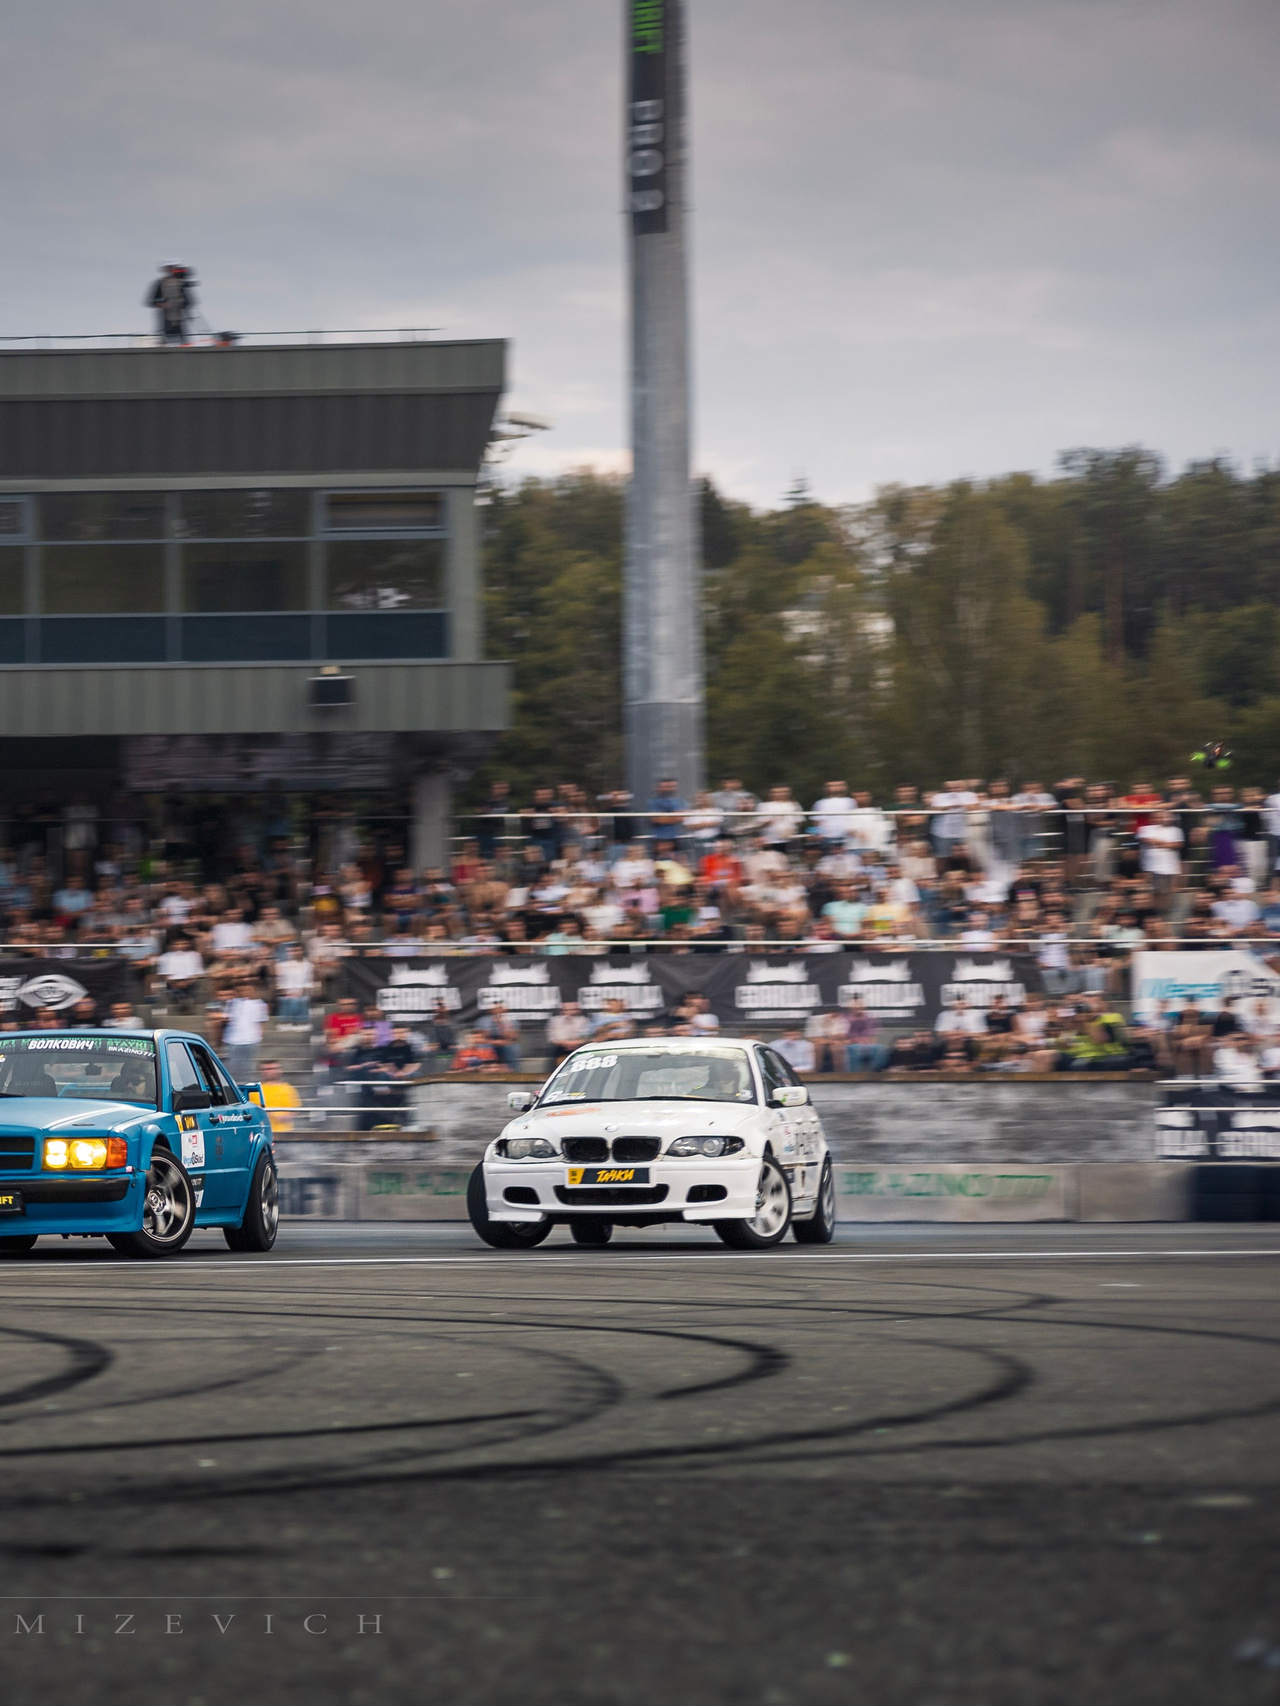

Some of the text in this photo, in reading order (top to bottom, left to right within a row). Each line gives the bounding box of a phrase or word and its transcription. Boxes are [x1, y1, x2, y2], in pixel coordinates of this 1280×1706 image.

[28, 1039, 95, 1051] ВОЛКОВИЧ
[570, 1055, 619, 1073] 888
[596, 1168, 636, 1183] ТАЧКИ
